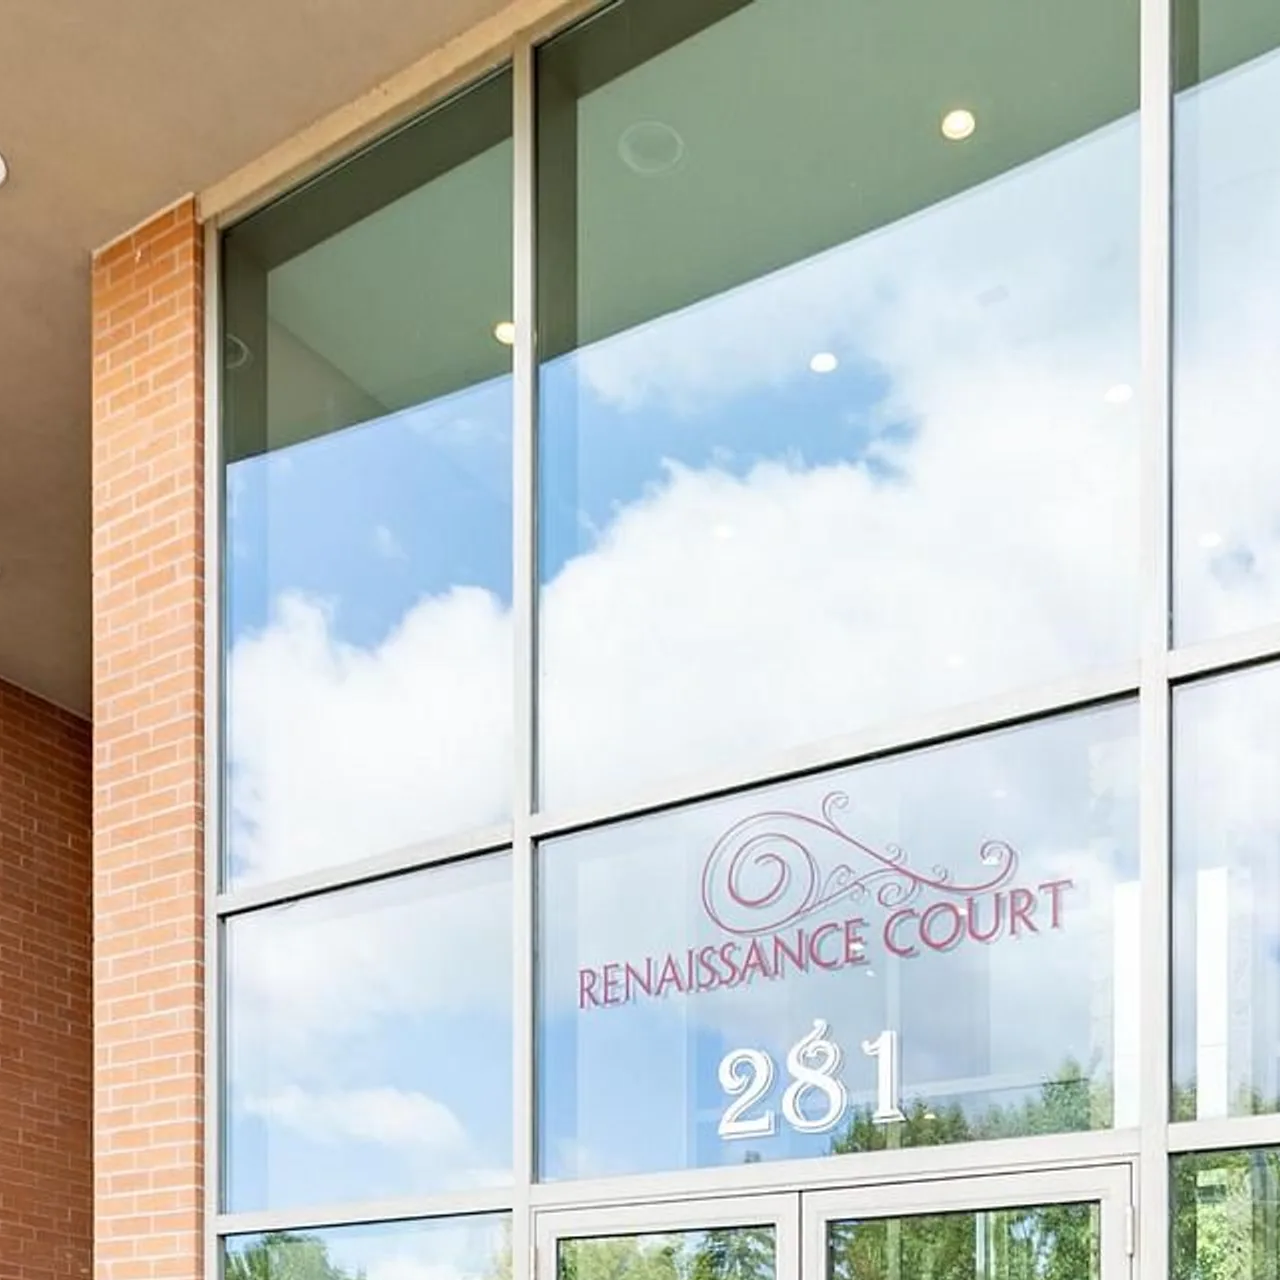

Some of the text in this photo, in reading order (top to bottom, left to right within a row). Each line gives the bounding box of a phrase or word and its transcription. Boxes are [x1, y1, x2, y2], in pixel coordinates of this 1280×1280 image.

[579, 879, 1074, 1010] RENAISSANCE COURT
[718, 1018, 906, 1140] 281
